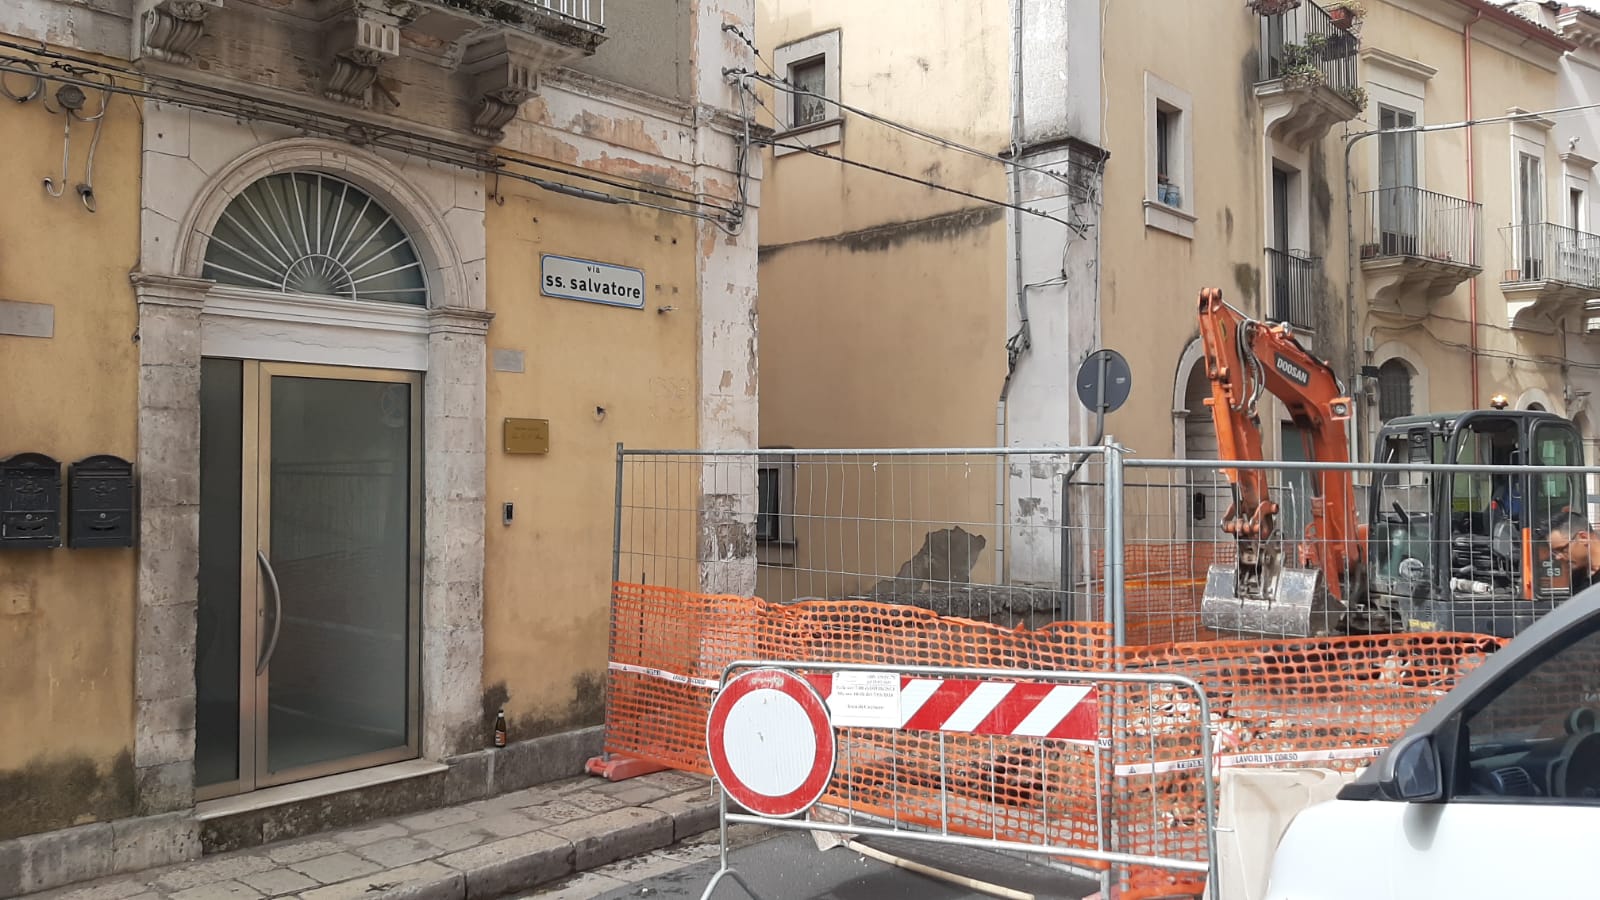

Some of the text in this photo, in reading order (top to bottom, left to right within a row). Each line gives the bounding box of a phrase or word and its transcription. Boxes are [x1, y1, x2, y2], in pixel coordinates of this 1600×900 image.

[587, 265, 601, 274] via
[570, 278, 641, 299] salvatore
[1276, 357, 1308, 384] DOOSAN
[1235, 752, 1298, 764] LAVORI IN CORSO
